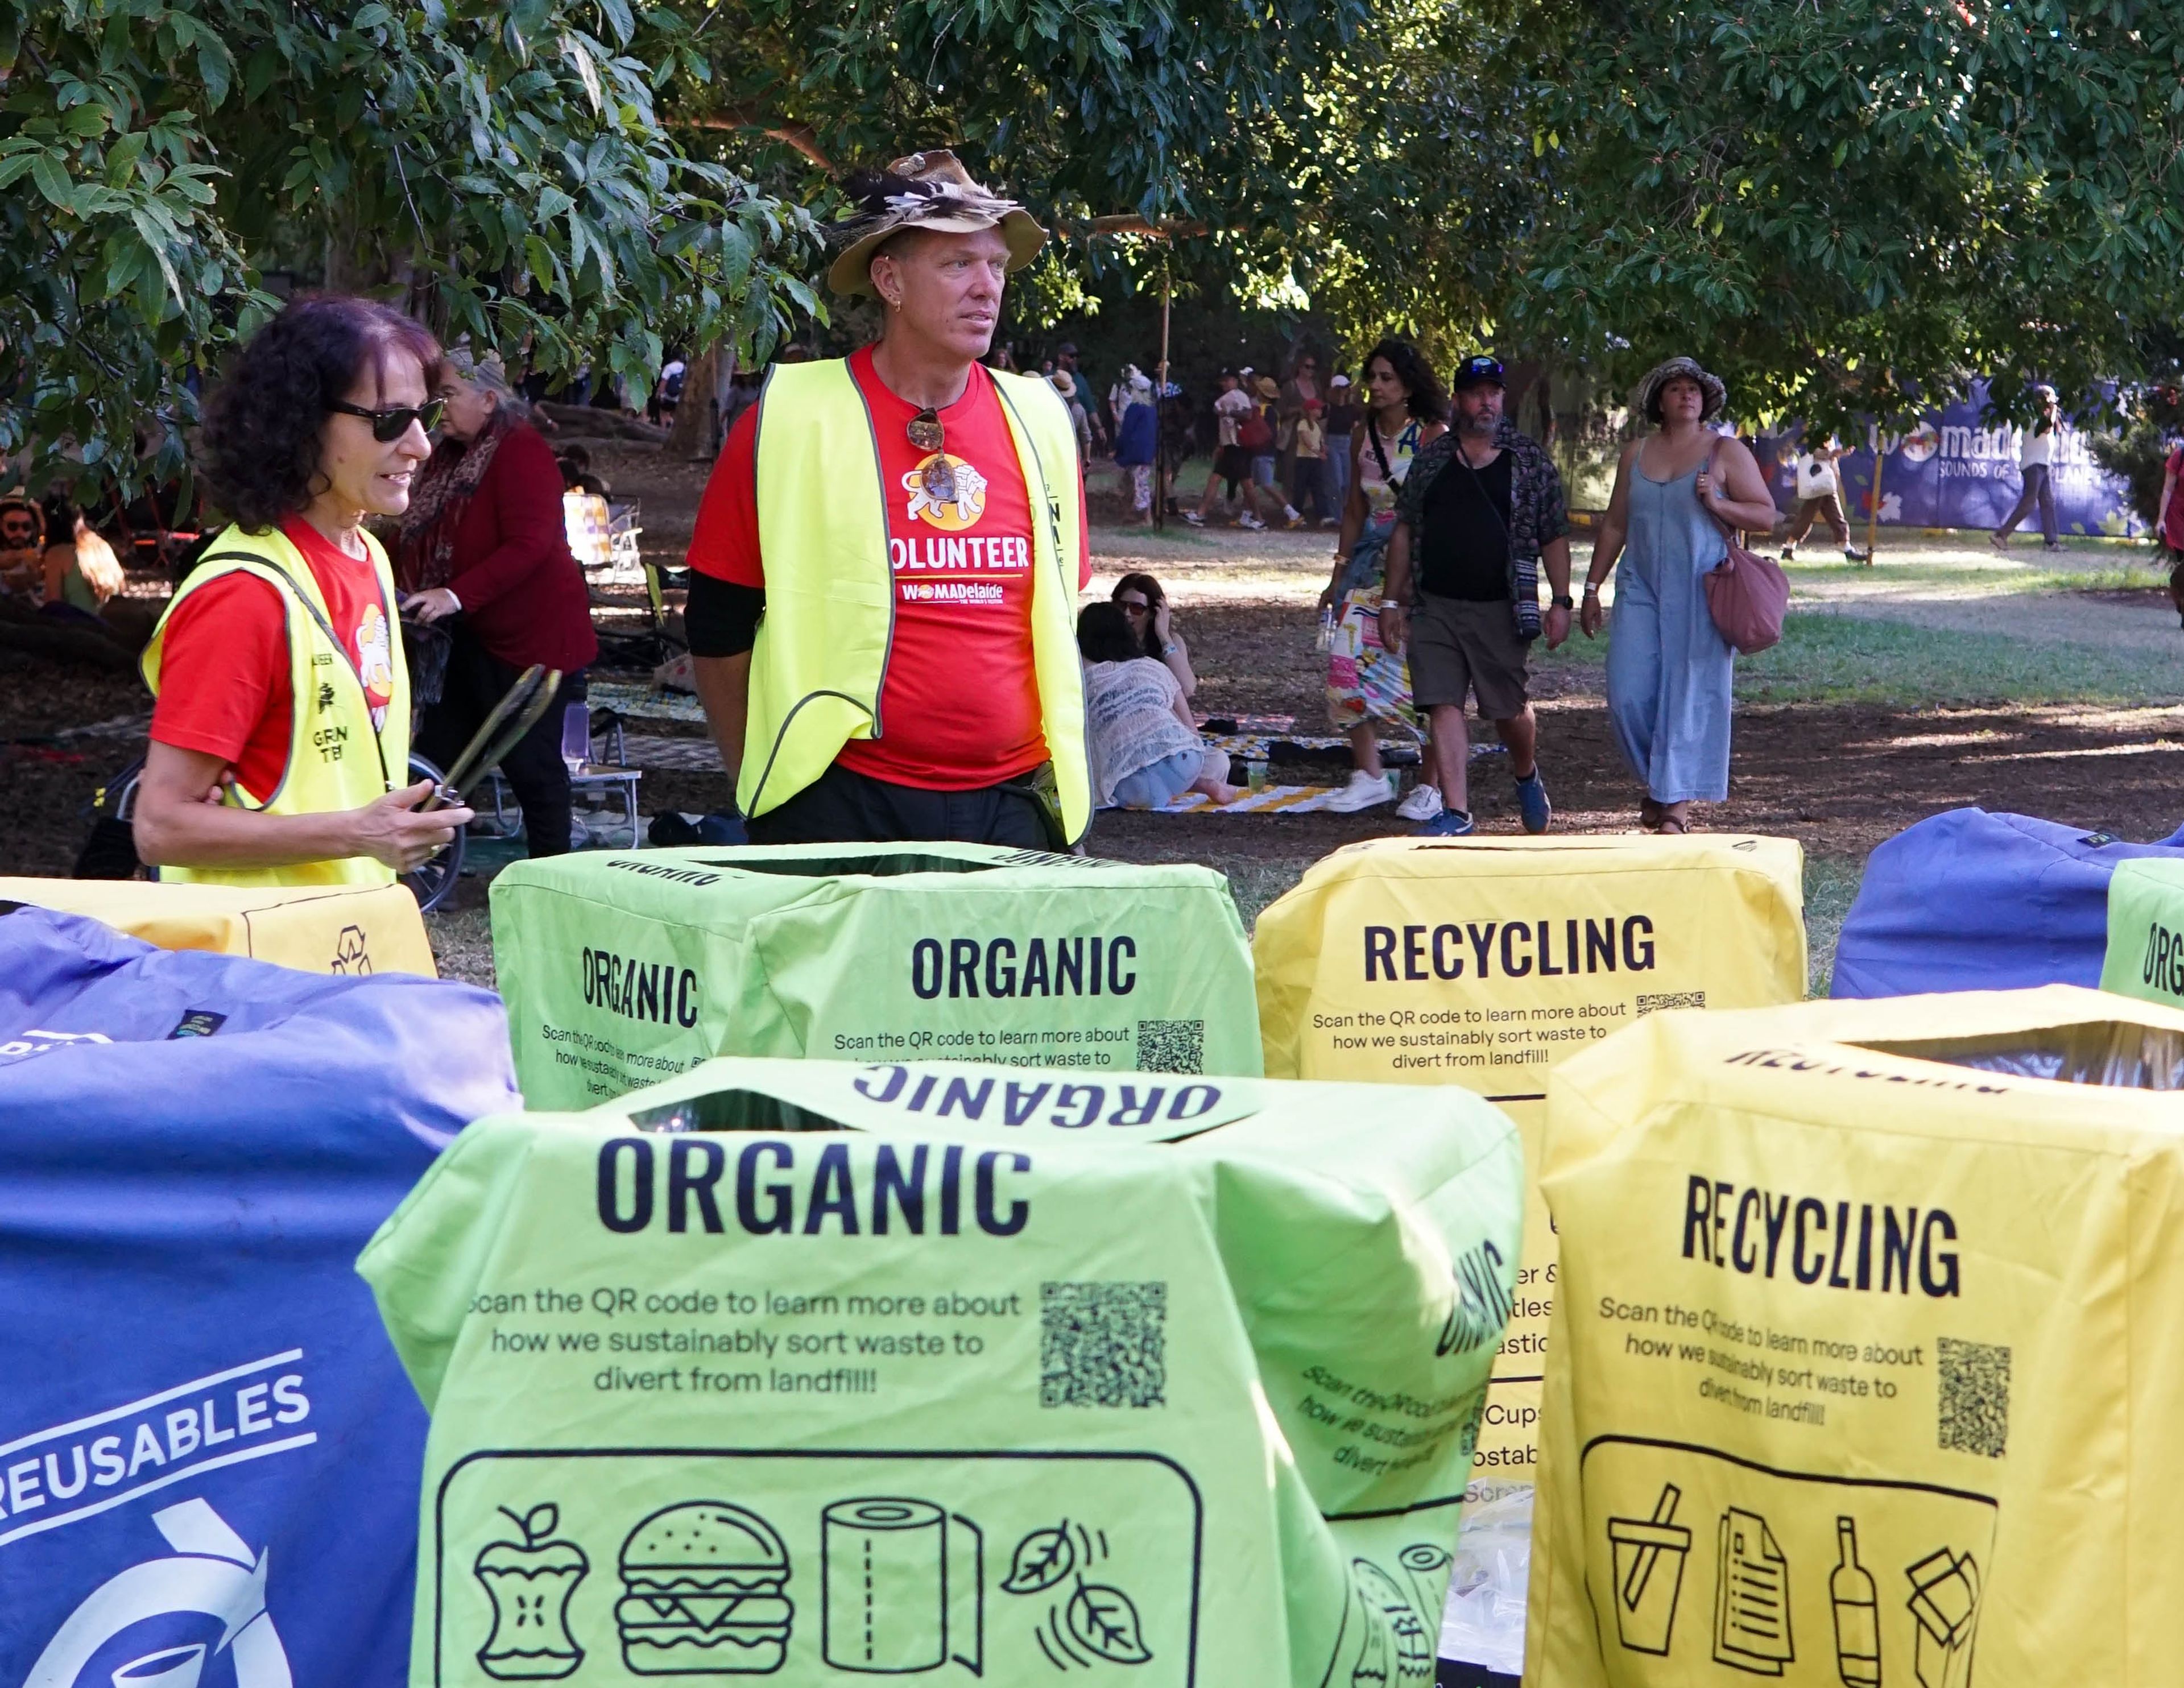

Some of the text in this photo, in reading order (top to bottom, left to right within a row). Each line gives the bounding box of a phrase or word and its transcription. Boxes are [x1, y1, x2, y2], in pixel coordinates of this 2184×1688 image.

[1939, 461, 1987, 478] SOUNDS
[890, 536, 1029, 569] OLUNTEER
[1364, 915, 1656, 982] RECYCLING
[2143, 922, 2184, 996] ORG
[912, 936, 1136, 999] ORGANIC
[583, 946, 697, 1028] ORGANIC
[1313, 1003, 1627, 1028] Scan the QR code to learn more about
[542, 1024, 572, 1043] Scan
[626, 1053, 654, 1068] more
[655, 1056, 685, 1074] about
[834, 1027, 1130, 1050] Scan the QR code to learn more about
[1333, 1025, 1607, 1049] how we sustainably sort waste to
[556, 1048, 579, 1067] how
[1010, 1052, 1041, 1067] sort
[1044, 1051, 1091, 1066] waste
[1094, 1050, 1111, 1065] to
[1393, 1049, 1549, 1069] divert from landfill!
[853, 1065, 1221, 1129] ORGANIC
[596, 1137, 1032, 1236] ORGANIC
[1681, 1174, 1960, 1298] RECYCLING
[535, 1287, 584, 1314] the
[591, 1286, 638, 1317] QR
[644, 1289, 719, 1315] code
[726, 1290, 757, 1315] to
[764, 1290, 840, 1316] learn
[847, 1296, 926, 1317] more
[934, 1291, 1021, 1317] about
[1512, 1297, 1553, 1318] tles
[491, 1326, 985, 1360] how we sustainably sort waste to
[1599, 1296, 1658, 1323] Scan
[1664, 1304, 1699, 1329] the
[1747, 1323, 1763, 1347] to
[1765, 1327, 1809, 1355] learn
[1811, 1337, 1858, 1362] more
[1861, 1341, 1924, 1366] about
[594, 1365, 878, 1394] divert from landfill!
[1625, 1331, 1674, 1358] how
[1678, 1342, 1706, 1364] we
[1777, 1365, 1813, 1390] sort
[1816, 1373, 1869, 1397] waste
[1873, 1377, 1898, 1399] to
[0, 1375, 310, 1520] EUSABLES
[1472, 1444, 1538, 1467] ostab
